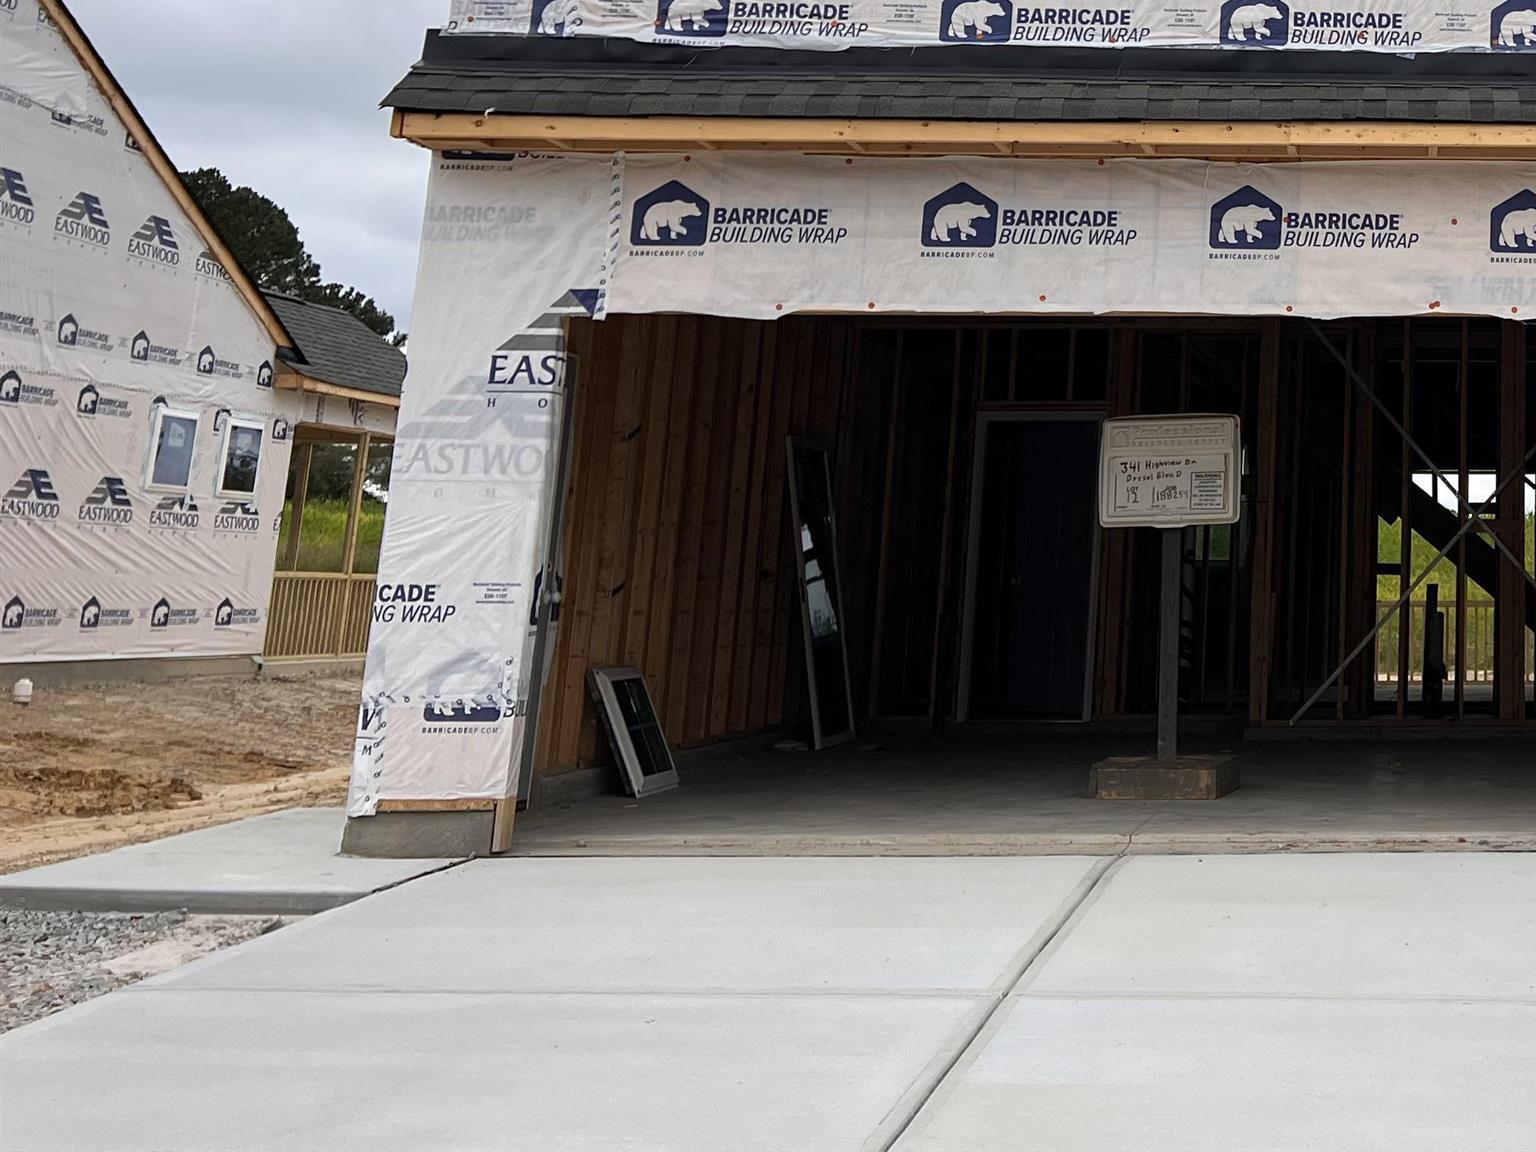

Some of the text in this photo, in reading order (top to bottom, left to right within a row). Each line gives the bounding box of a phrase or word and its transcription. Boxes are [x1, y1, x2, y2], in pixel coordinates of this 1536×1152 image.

[735, 3, 850, 20] BARRICADE
[1017, 9, 1130, 25] BARRICADE
[730, 20, 868, 38] BUILDING WRAP
[1293, 13, 1402, 28] BARRICADE
[1014, 27, 1150, 43] BUILDING WRAP
[1291, 30, 1422, 46] BUILDING WRAP
[713, 208, 828, 225] BARRICADE
[1002, 210, 1117, 226] BARRICADE
[1287, 213, 1400, 230] BARRICADE
[55, 217, 109, 246] EASTWOOD
[709, 226, 847, 244] BUILDING WRAP
[998, 230, 1136, 246] BUILDING WRAP
[1284, 231, 1419, 249] BUILDING WRAP
[128, 239, 179, 265] EASTWOOD
[1120, 462, 1140, 473] 341
[1145, 459, 1181, 470] Highview
[0, 499, 59, 519] EASTWOOD
[79, 506, 133, 523] EASTWOOD
[149, 510, 199, 527] EASTWOOD
[214, 515, 259, 531] EASTWOOD
[401, 606, 455, 623] WRAP
